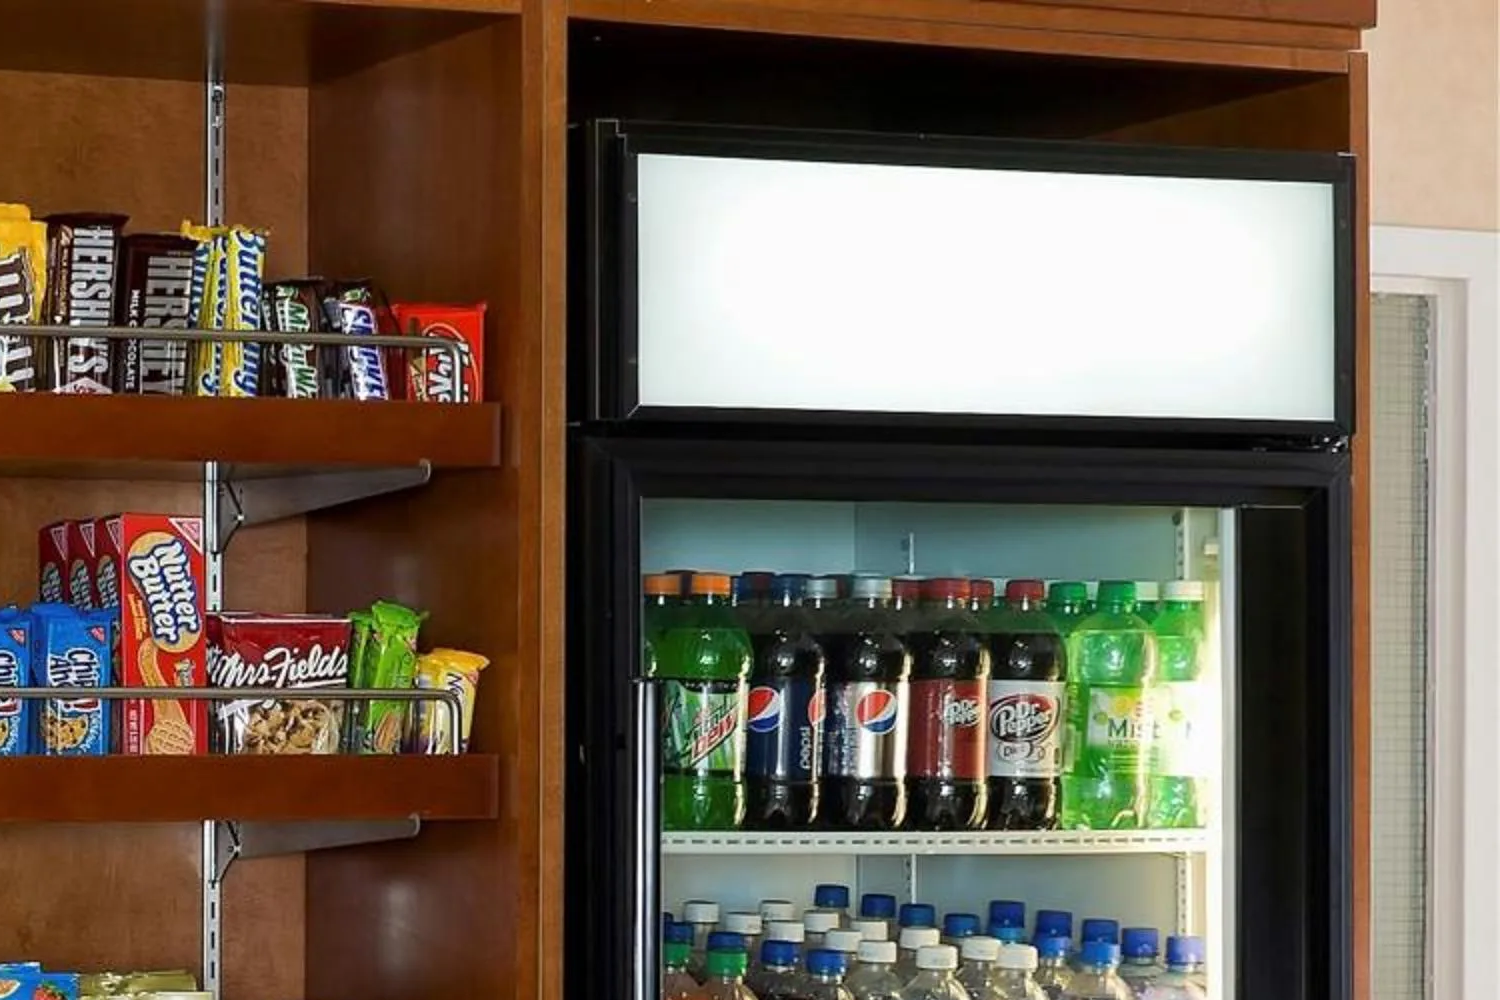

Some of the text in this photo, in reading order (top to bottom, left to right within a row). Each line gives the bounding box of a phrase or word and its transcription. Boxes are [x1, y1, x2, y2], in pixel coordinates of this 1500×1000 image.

[124, 320, 138, 389] COCOLATE
[129, 552, 178, 645] Butter
[153, 537, 201, 636] Nutter
[266, 646, 349, 688] Fields
[800, 726, 812, 770] pepsi
